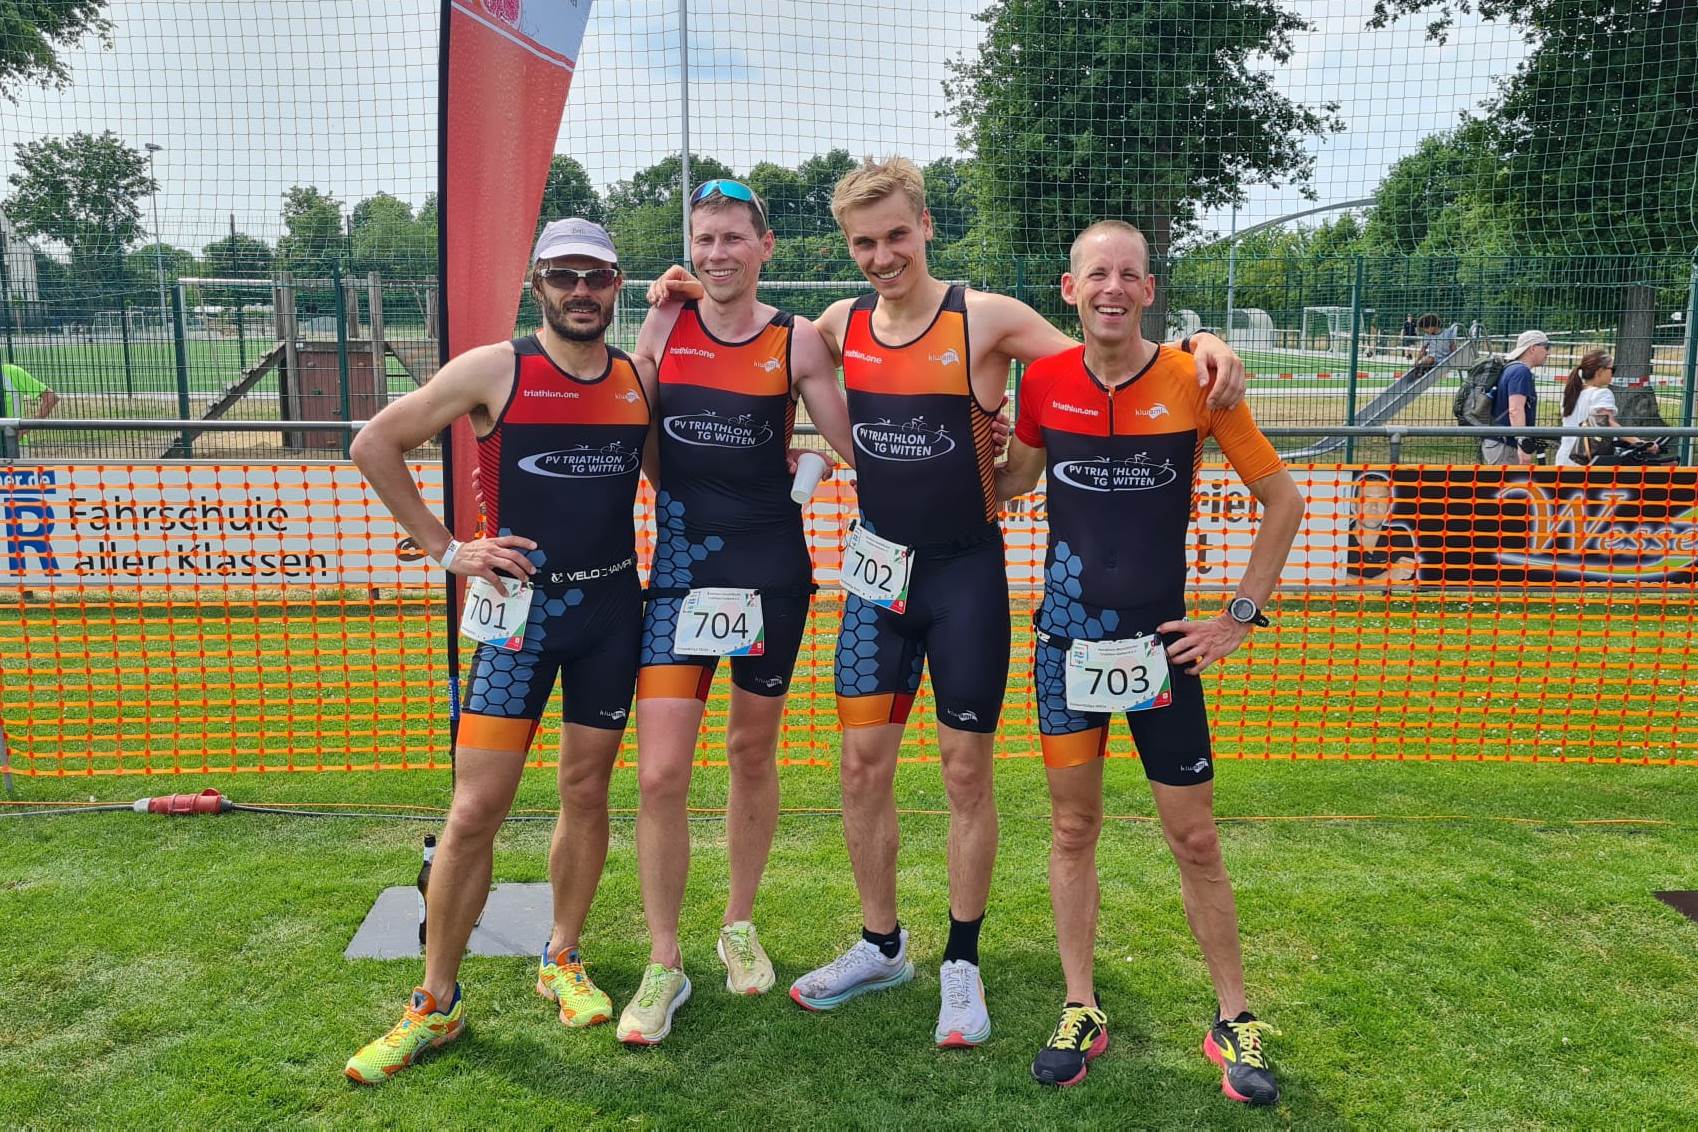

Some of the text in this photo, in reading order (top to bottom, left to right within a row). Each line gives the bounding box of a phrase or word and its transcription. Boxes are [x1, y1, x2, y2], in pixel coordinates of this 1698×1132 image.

[674, 420, 752, 437] PV TRIATHLON
[860, 427, 926, 445] PV TRIATHLON
[697, 431, 756, 445] TG WITTEN
[874, 442, 932, 456] TG WITTEN
[545, 455, 622, 464] PV TRIATHLON
[571, 464, 625, 473] TG WITTEN
[1069, 465, 1083, 474] PV
[1093, 476, 1155, 486] TG WITTEN
[68, 496, 289, 532] Fahrschule
[74, 542, 327, 577] aller Klassen
[853, 550, 892, 593] 702
[470, 593, 507, 630] 701
[693, 611, 749, 640] 704
[1084, 665, 1150, 696] 703
